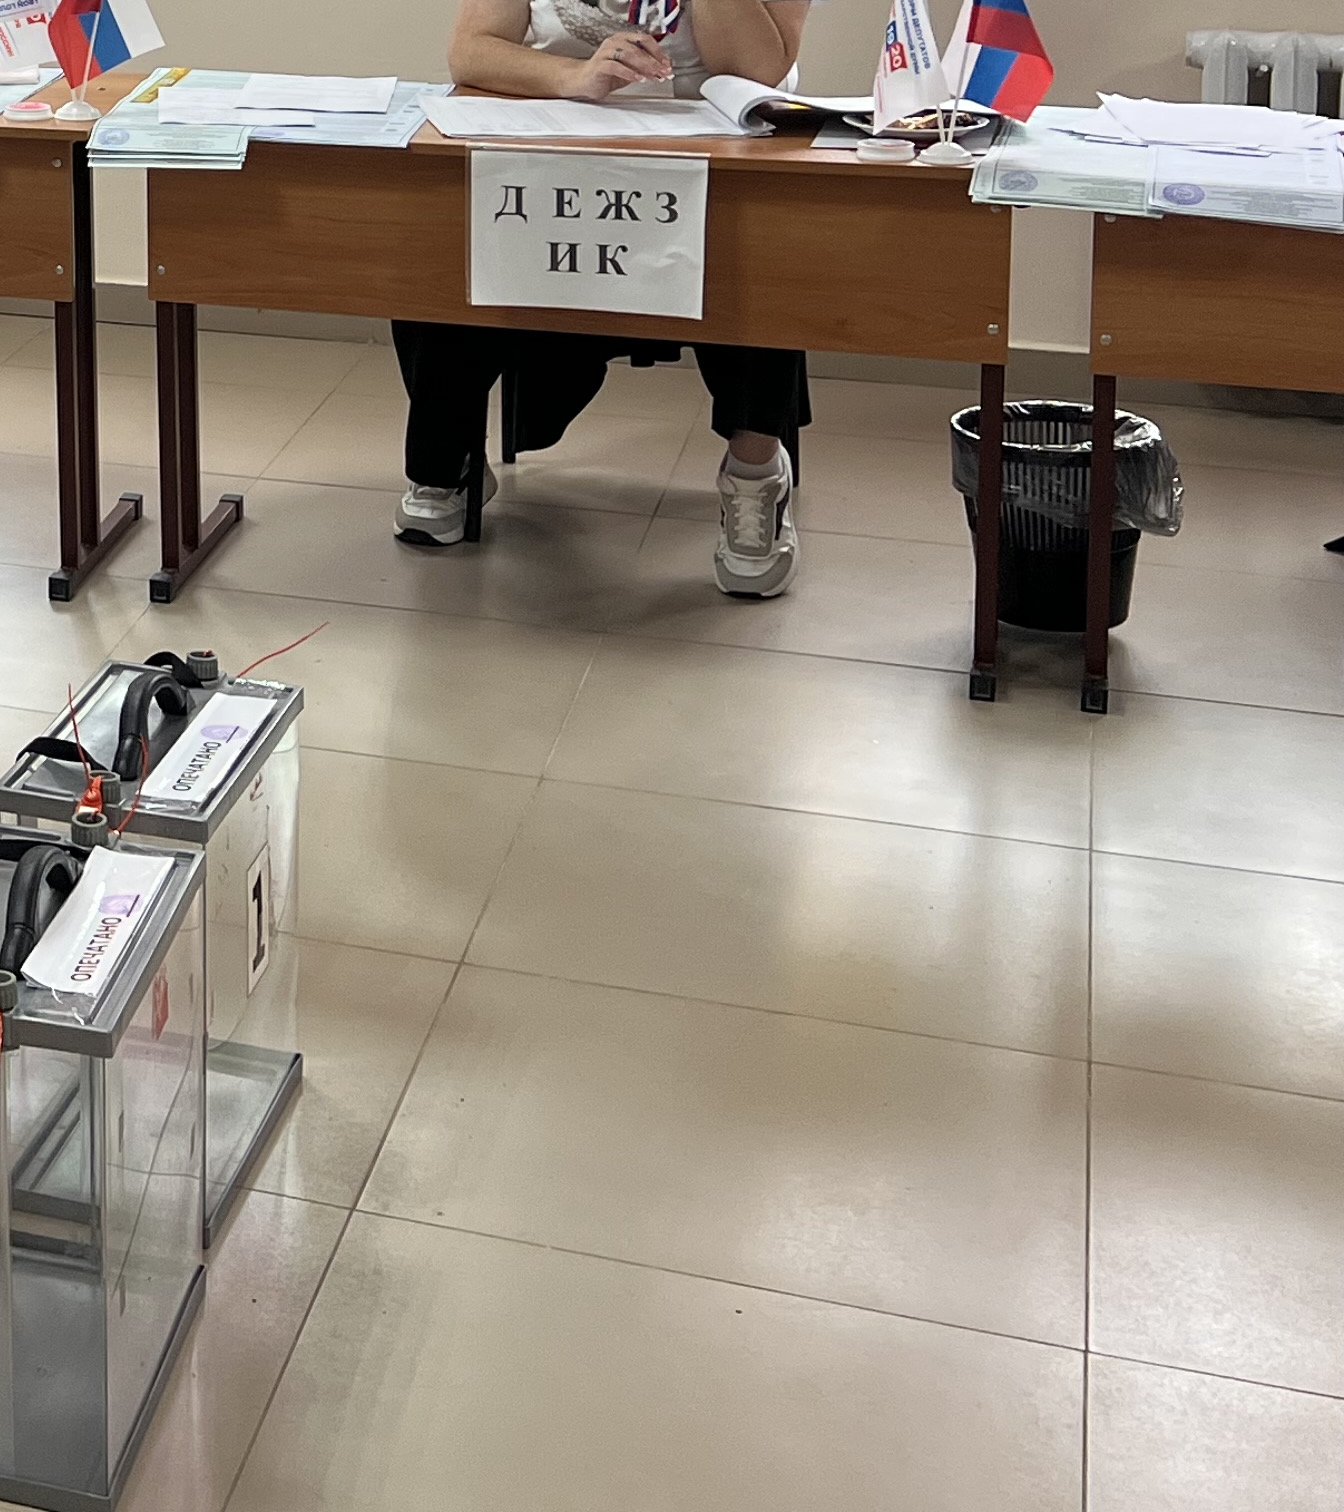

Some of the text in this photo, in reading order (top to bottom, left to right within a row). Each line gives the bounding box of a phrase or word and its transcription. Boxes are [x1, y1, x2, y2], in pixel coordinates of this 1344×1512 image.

[890, 43, 903, 69] 20
[912, 18, 931, 69] ДЕПУТАТОВ
[494, 185, 679, 223] Д Е Ж З
[546, 241, 628, 276] И К
[171, 741, 222, 792] ОПЕЧАТАНО
[252, 869, 266, 974] 1
[70, 916, 122, 982] ОПЕЧАТАНО
